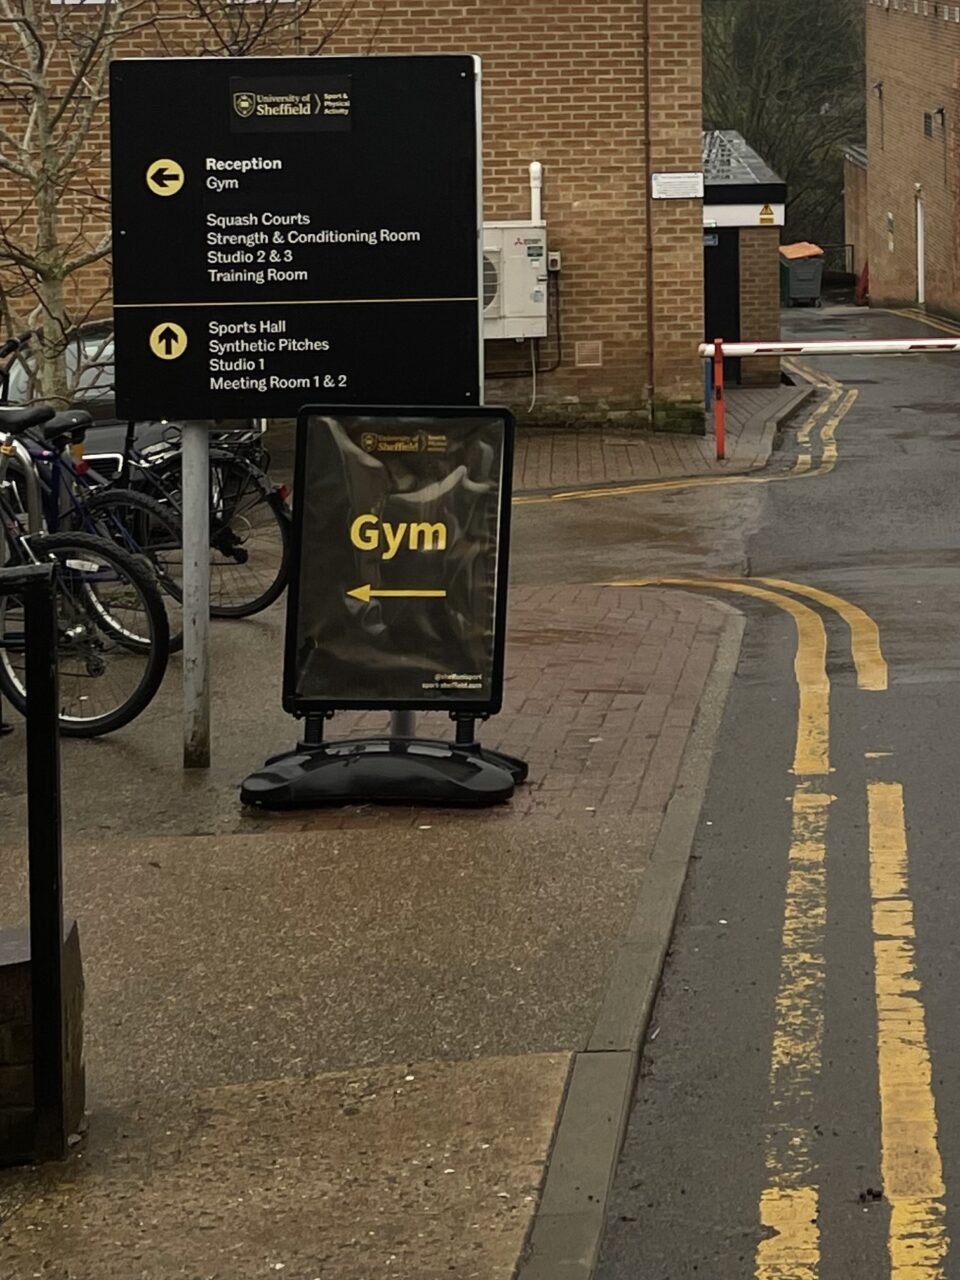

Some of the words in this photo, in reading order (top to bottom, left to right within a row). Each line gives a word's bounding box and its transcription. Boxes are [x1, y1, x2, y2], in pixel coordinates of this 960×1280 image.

[256, 93, 303, 104] University
[304, 93, 311, 102] of
[256, 103, 311, 116] Sheffield
[206, 157, 282, 173] Reception
[206, 176, 239, 192] Gym
[206, 213, 258, 229] Squash
[261, 212, 310, 226] Courts
[207, 231, 269, 247] Strength
[272, 231, 285, 244] &
[287, 230, 377, 245] Conditioning
[380, 229, 420, 242] Room
[207, 250, 254, 264] Studio
[256, 250, 266, 263] 2
[269, 249, 282, 263] &
[283, 249, 293, 262] 3
[208, 269, 265, 284] Training
[267, 268, 308, 281] Room
[208, 321, 257, 337] Sports
[259, 320, 286, 333] Hall
[209, 339, 276, 355] Synthetic
[278, 338, 330, 351] Pitches
[209, 358, 256, 371] Studio
[258, 358, 265, 370] 1
[210, 377, 267, 392] Meeting
[270, 375, 310, 388] Room
[313, 375, 319, 387] 1
[323, 374, 335, 387] &
[338, 374, 347, 387] 2
[350, 513, 447, 560] Gym
